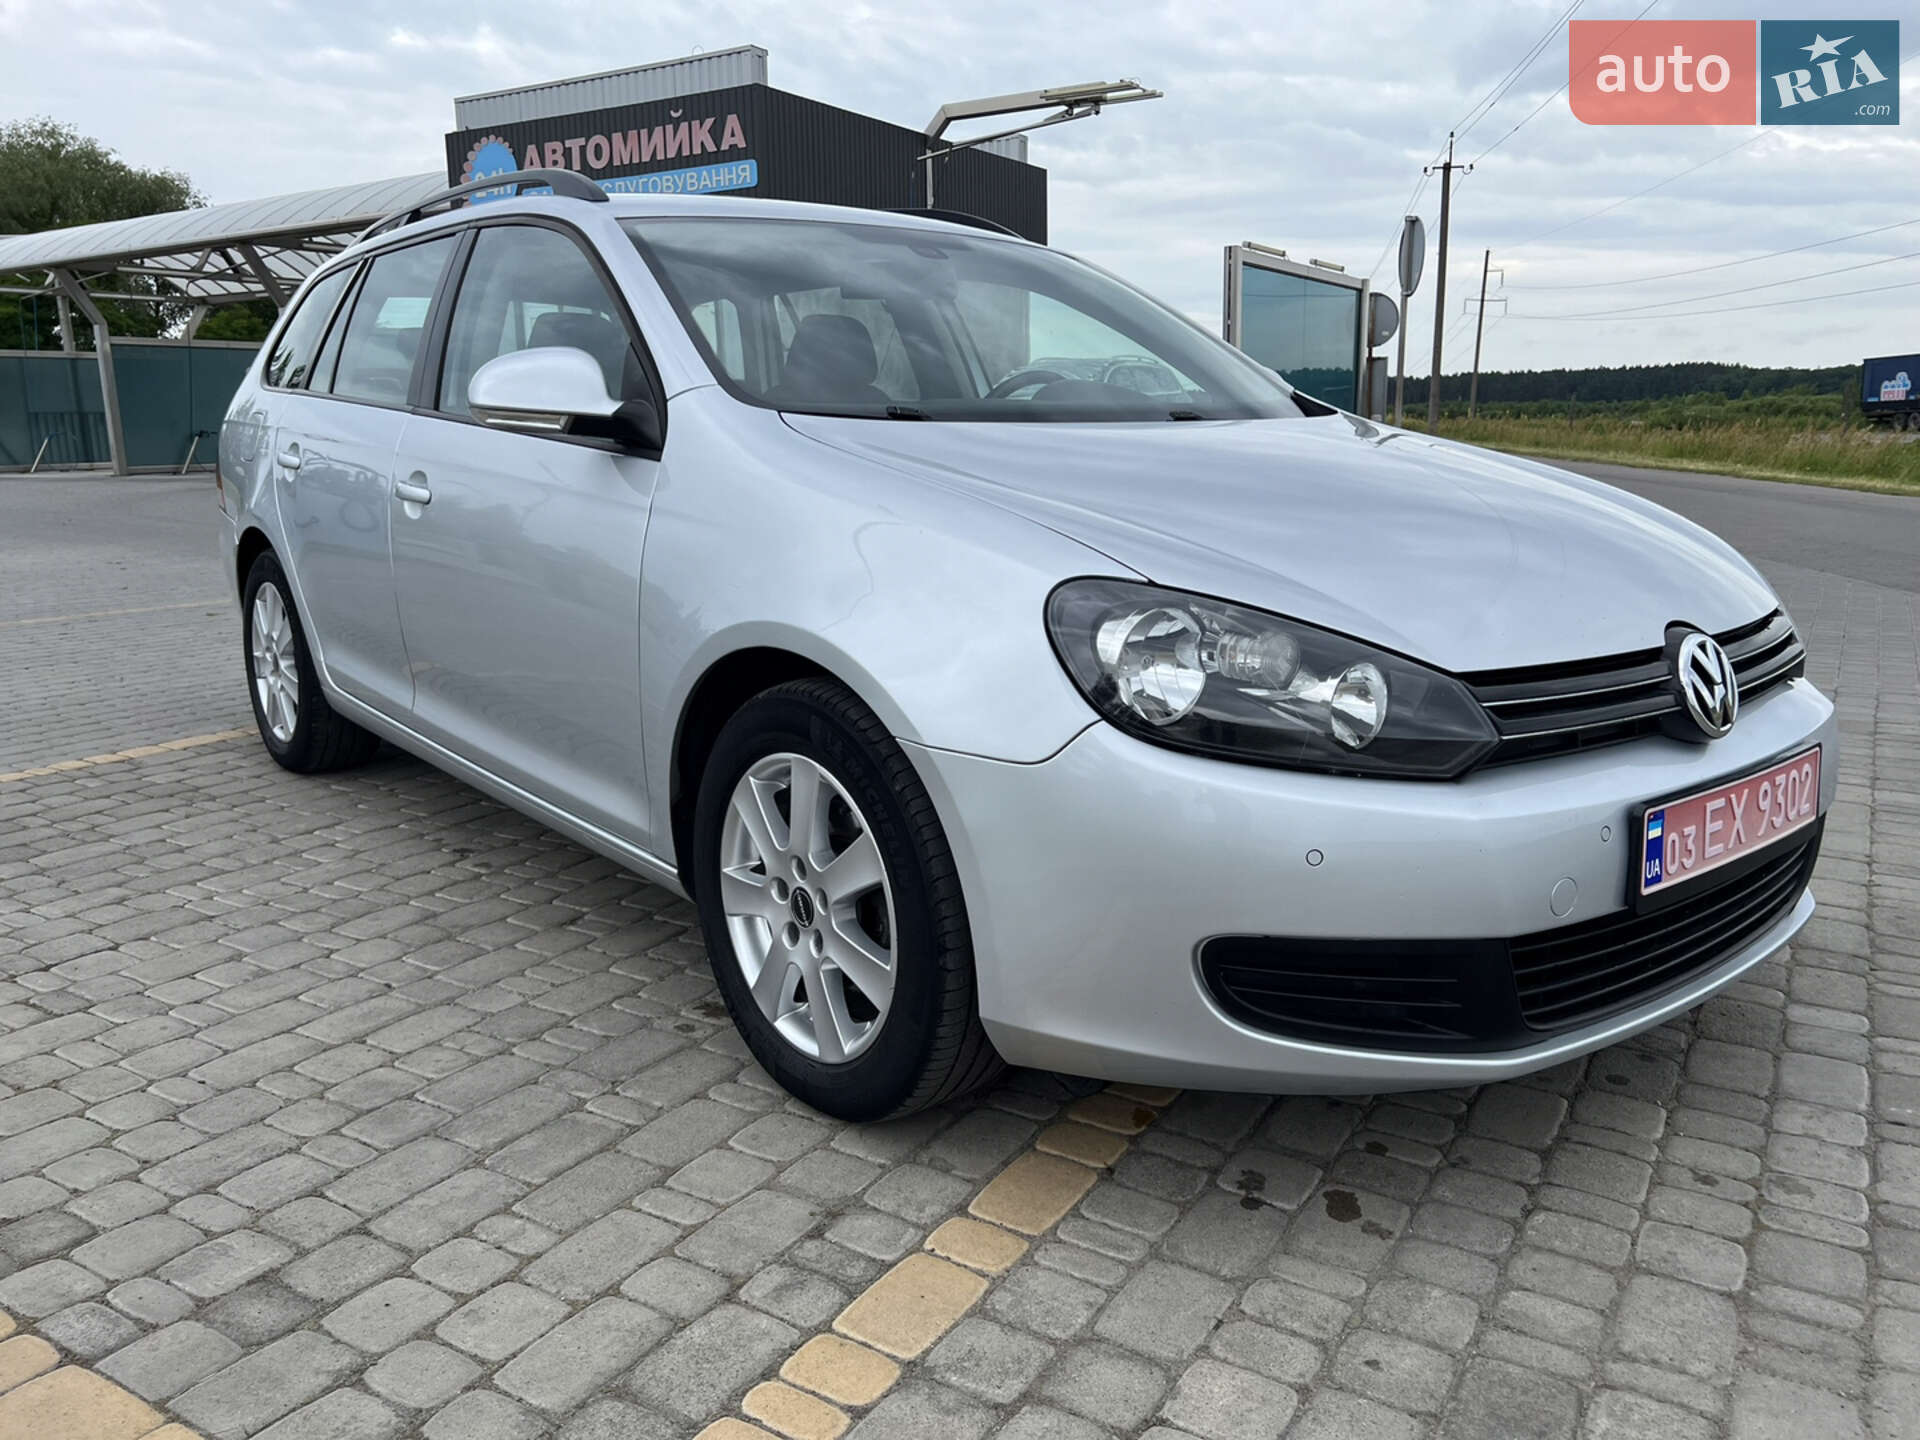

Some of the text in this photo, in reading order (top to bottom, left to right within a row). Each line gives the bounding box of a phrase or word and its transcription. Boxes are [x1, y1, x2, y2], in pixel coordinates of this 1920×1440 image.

[522, 109, 748, 171] АВТОМИЙКА
[1665, 762, 1814, 875] 03 EX 9302
[1645, 858, 1662, 879] UA
